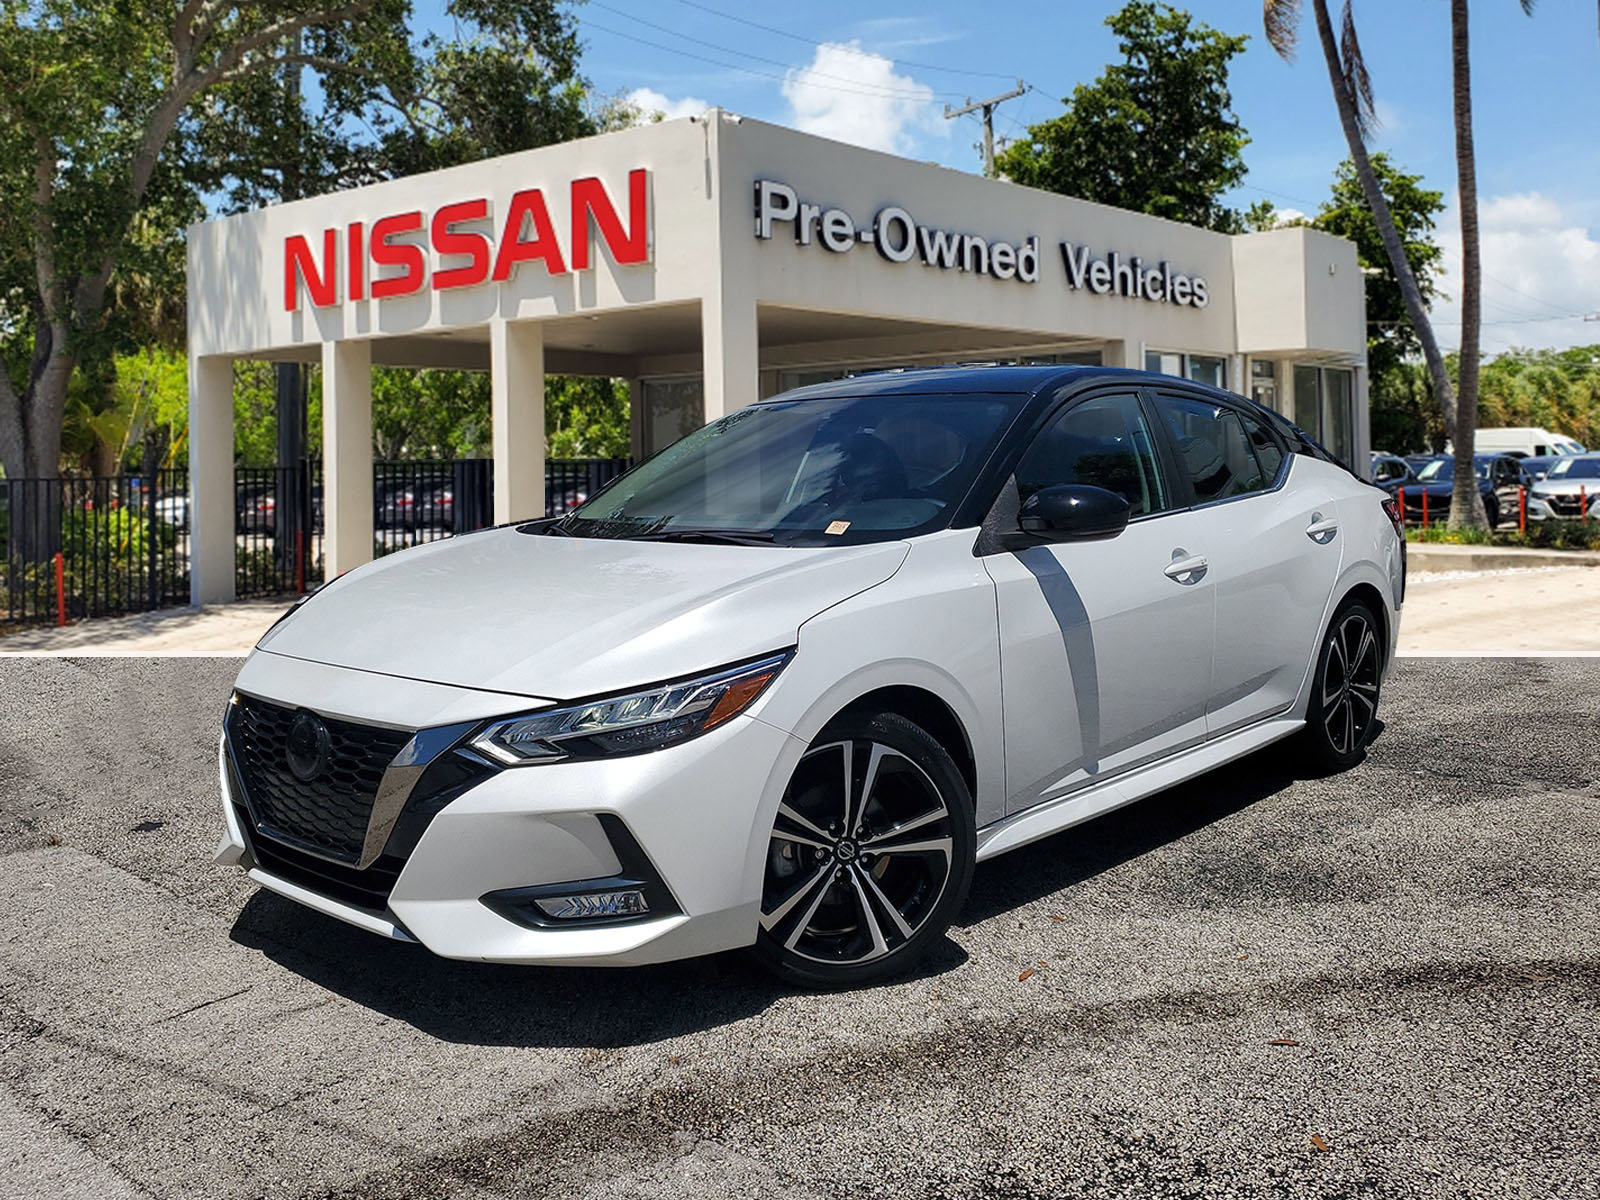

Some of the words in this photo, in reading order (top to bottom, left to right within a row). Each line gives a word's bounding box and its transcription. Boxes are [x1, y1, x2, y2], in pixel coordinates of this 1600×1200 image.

[285, 168, 648, 312] NISSAN
[755, 180, 1040, 283] Pre-Owned
[1060, 242, 1209, 308] Vehicles
